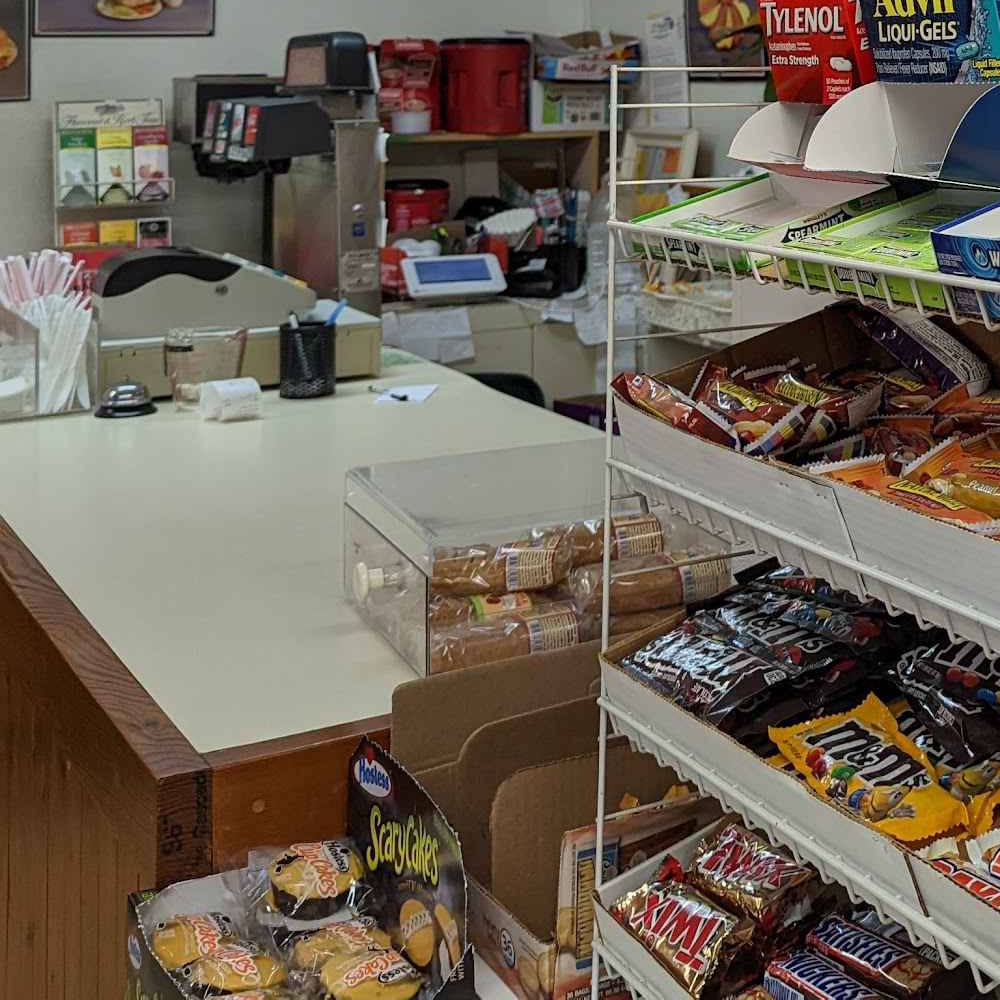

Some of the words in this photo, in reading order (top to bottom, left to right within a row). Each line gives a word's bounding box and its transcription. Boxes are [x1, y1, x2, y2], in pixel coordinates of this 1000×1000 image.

[760, 1, 845, 38] TYLENOL
[771, 55, 789, 65] Extra
[788, 55, 820, 67] Strength
[972, 59, 987, 69] Liquid
[788, 213, 846, 242] SPEARMINT
[967, 480, 999, 495] Peanut
[358, 757, 390, 792] Hostess
[290, 842, 319, 866] Cup
[310, 857, 339, 898] Cakes
[321, 840, 350, 872] Hostess
[501, 934, 513, 952] 36
[630, 890, 726, 974] TWIX
